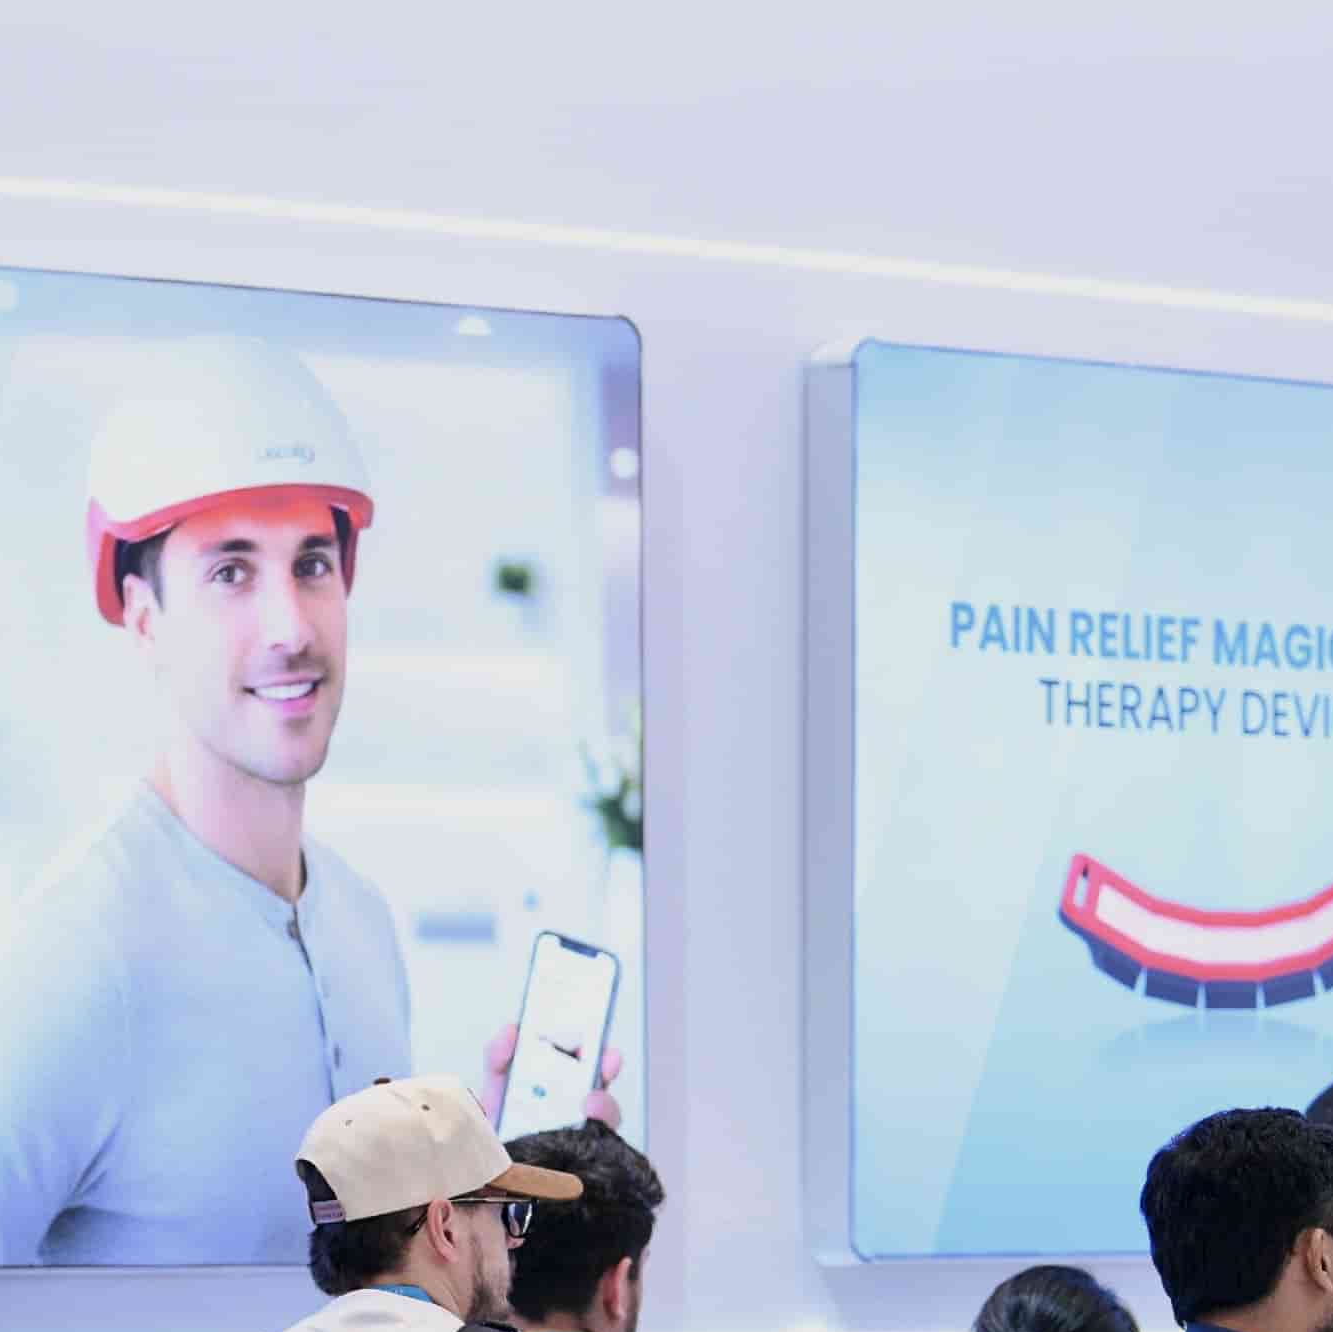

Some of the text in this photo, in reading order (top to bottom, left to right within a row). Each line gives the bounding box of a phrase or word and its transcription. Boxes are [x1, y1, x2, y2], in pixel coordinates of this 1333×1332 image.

[949, 601, 1056, 655] PAIN
[1069, 610, 1200, 662] RELIEF
[1039, 678, 1226, 733] THERAPY
